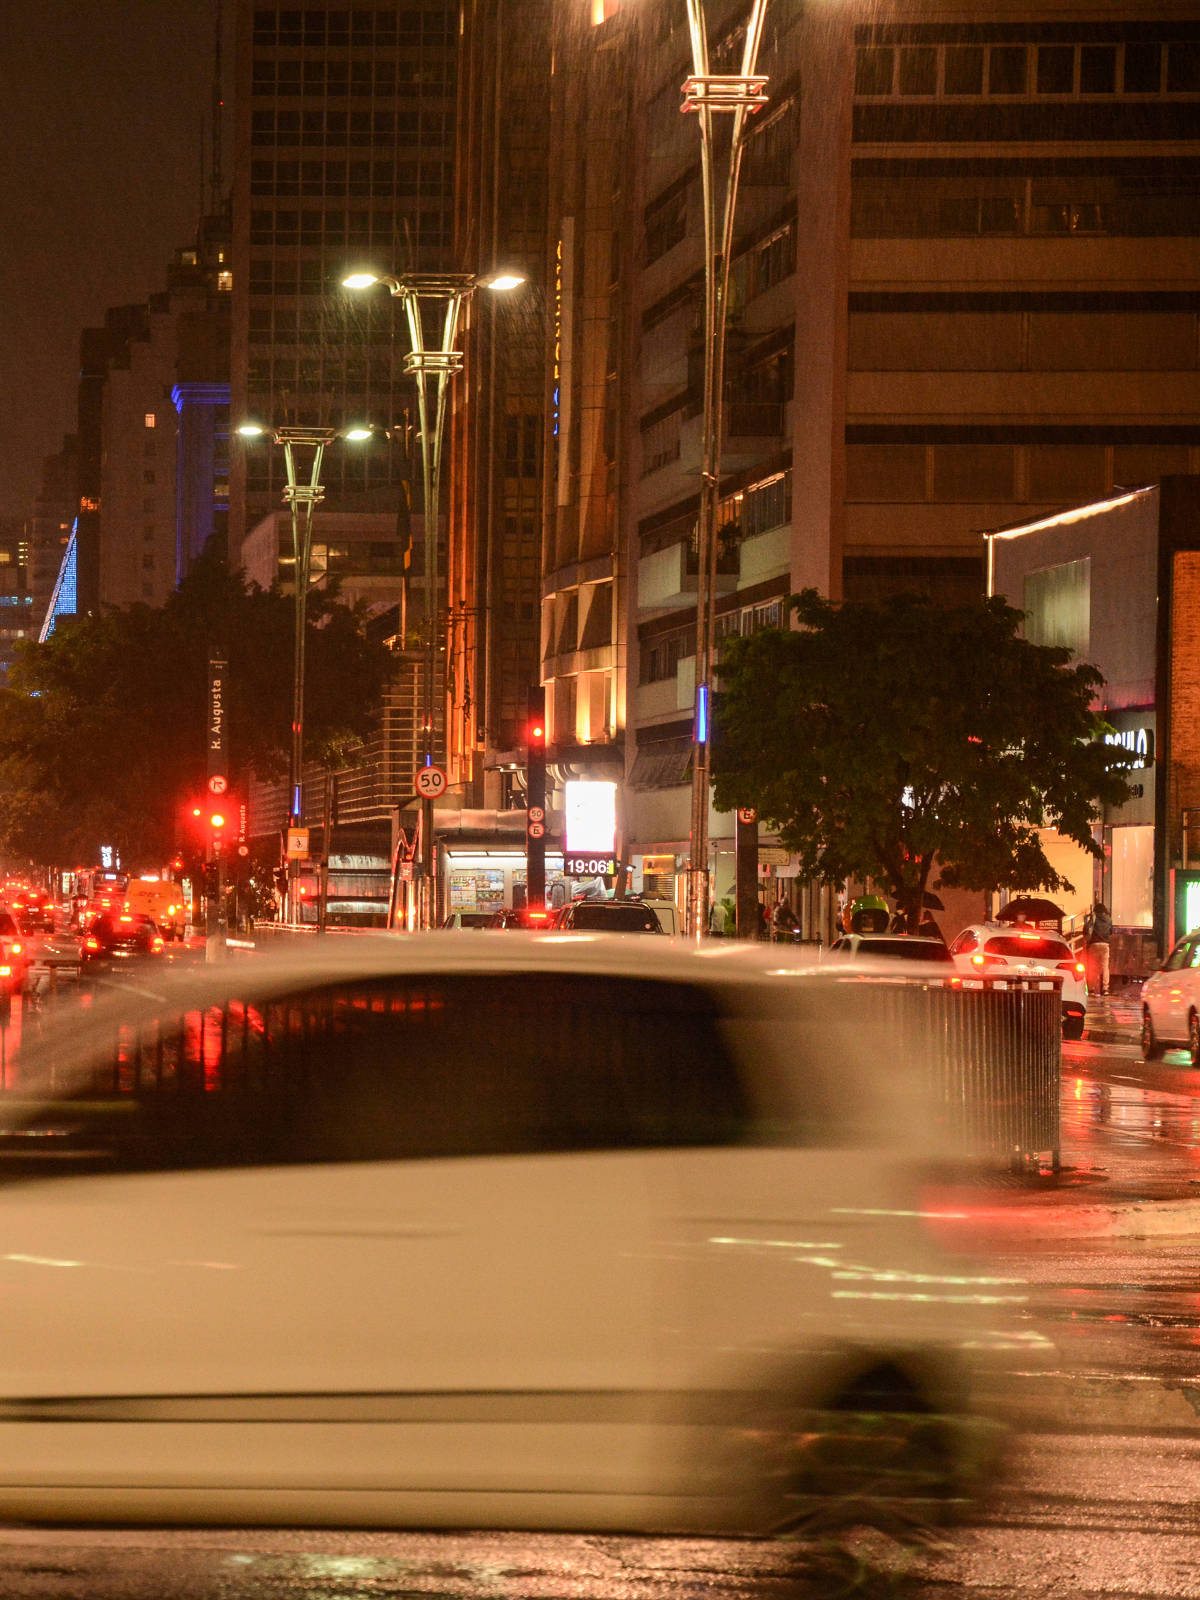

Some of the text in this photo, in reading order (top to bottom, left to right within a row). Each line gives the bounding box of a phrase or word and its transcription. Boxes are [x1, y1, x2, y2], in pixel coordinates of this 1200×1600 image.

[210, 679, 224, 735] Augusta
[421, 773, 442, 788] 50
[531, 810, 542, 818] 50
[567, 859, 607, 875] 19:06
